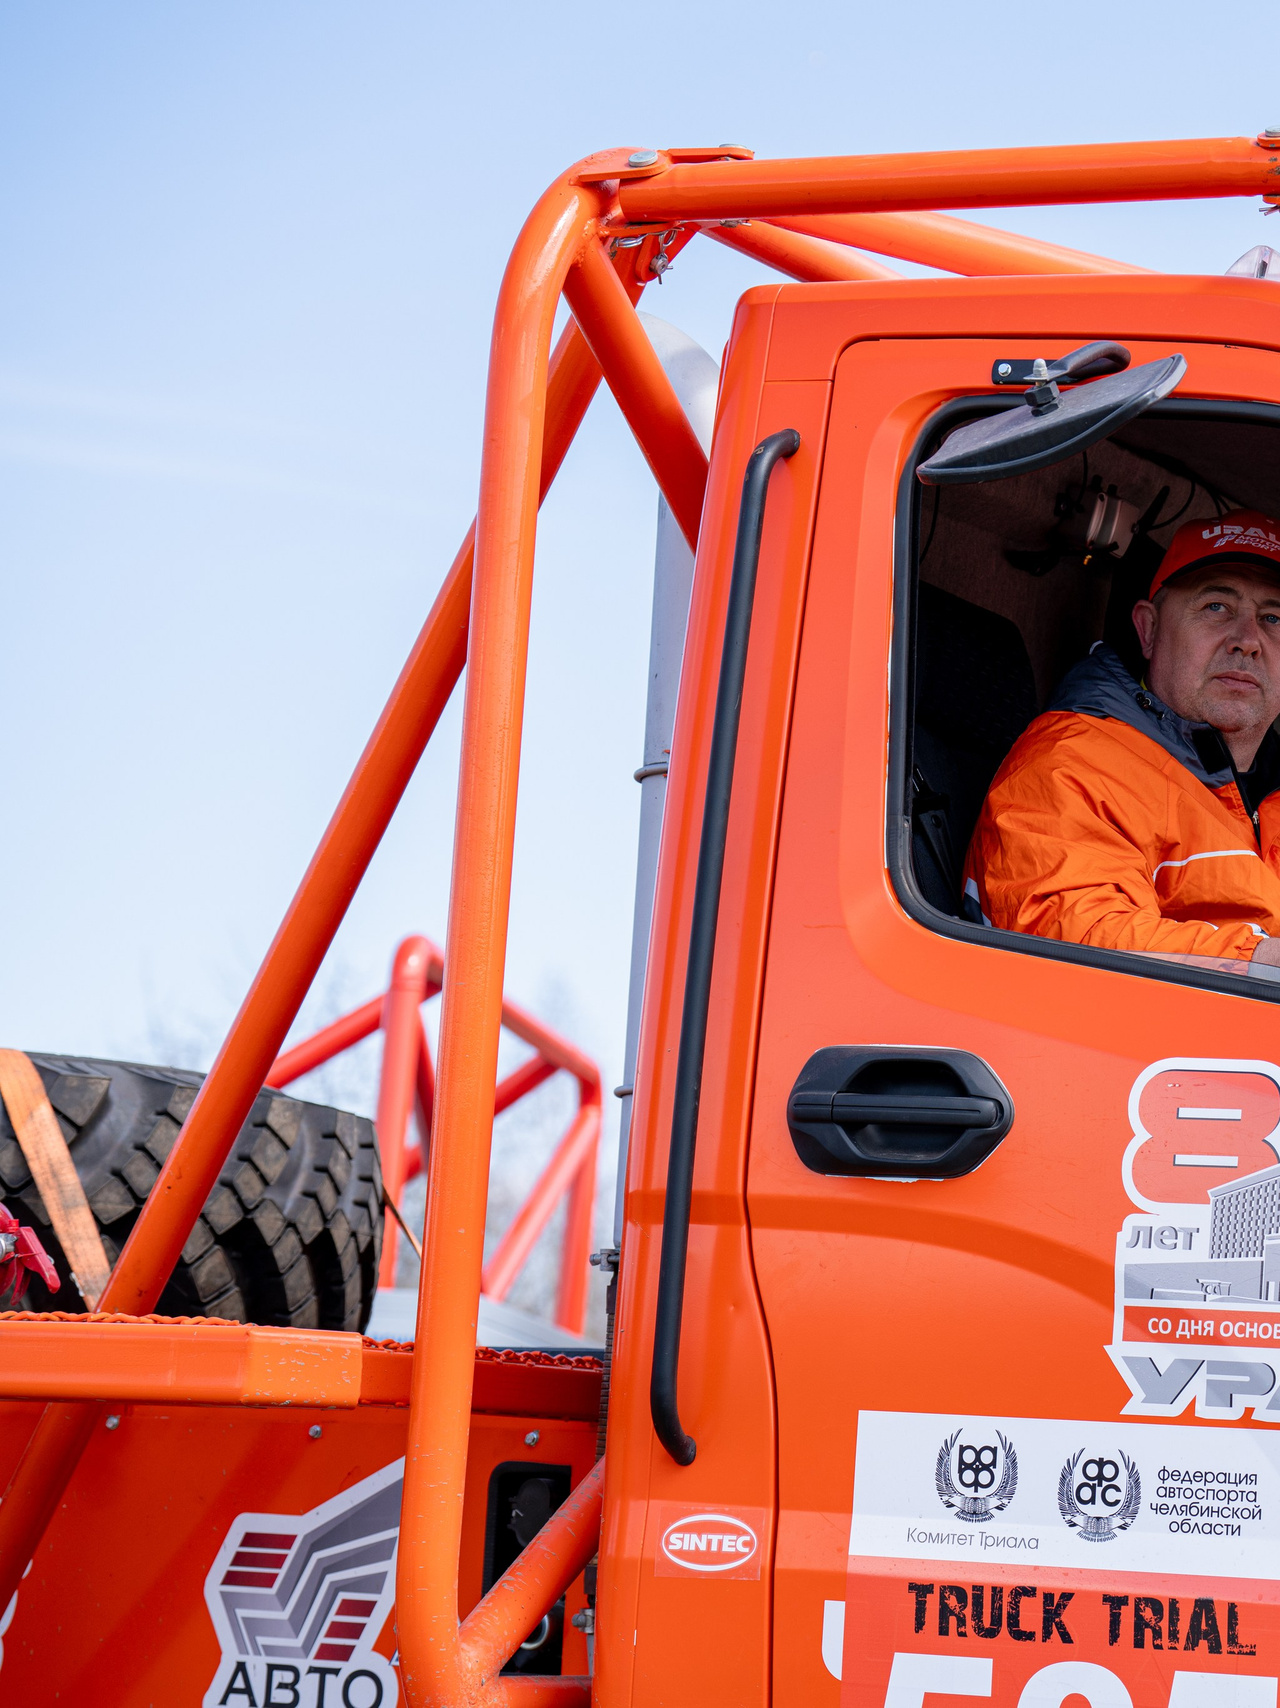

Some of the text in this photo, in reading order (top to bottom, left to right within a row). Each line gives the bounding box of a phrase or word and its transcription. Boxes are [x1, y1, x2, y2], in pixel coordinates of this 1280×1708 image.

[1234, 538, 1278, 552] SPORT
[1125, 1223, 1200, 1251] лет
[1148, 1317, 1172, 1335] СО
[1176, 1319, 1215, 1339] ДНЯ
[1157, 1465, 1258, 1486] федерация
[1156, 1486, 1258, 1504] автоспорта
[1149, 1502, 1262, 1520] челябинской
[1168, 1519, 1241, 1536] области
[668, 1533, 751, 1553] SINTEC
[906, 1527, 1040, 1550] Комитет Триала
[907, 1582, 1257, 1656] TRUCK TRIAL
[218, 1661, 384, 1708] АВТО
